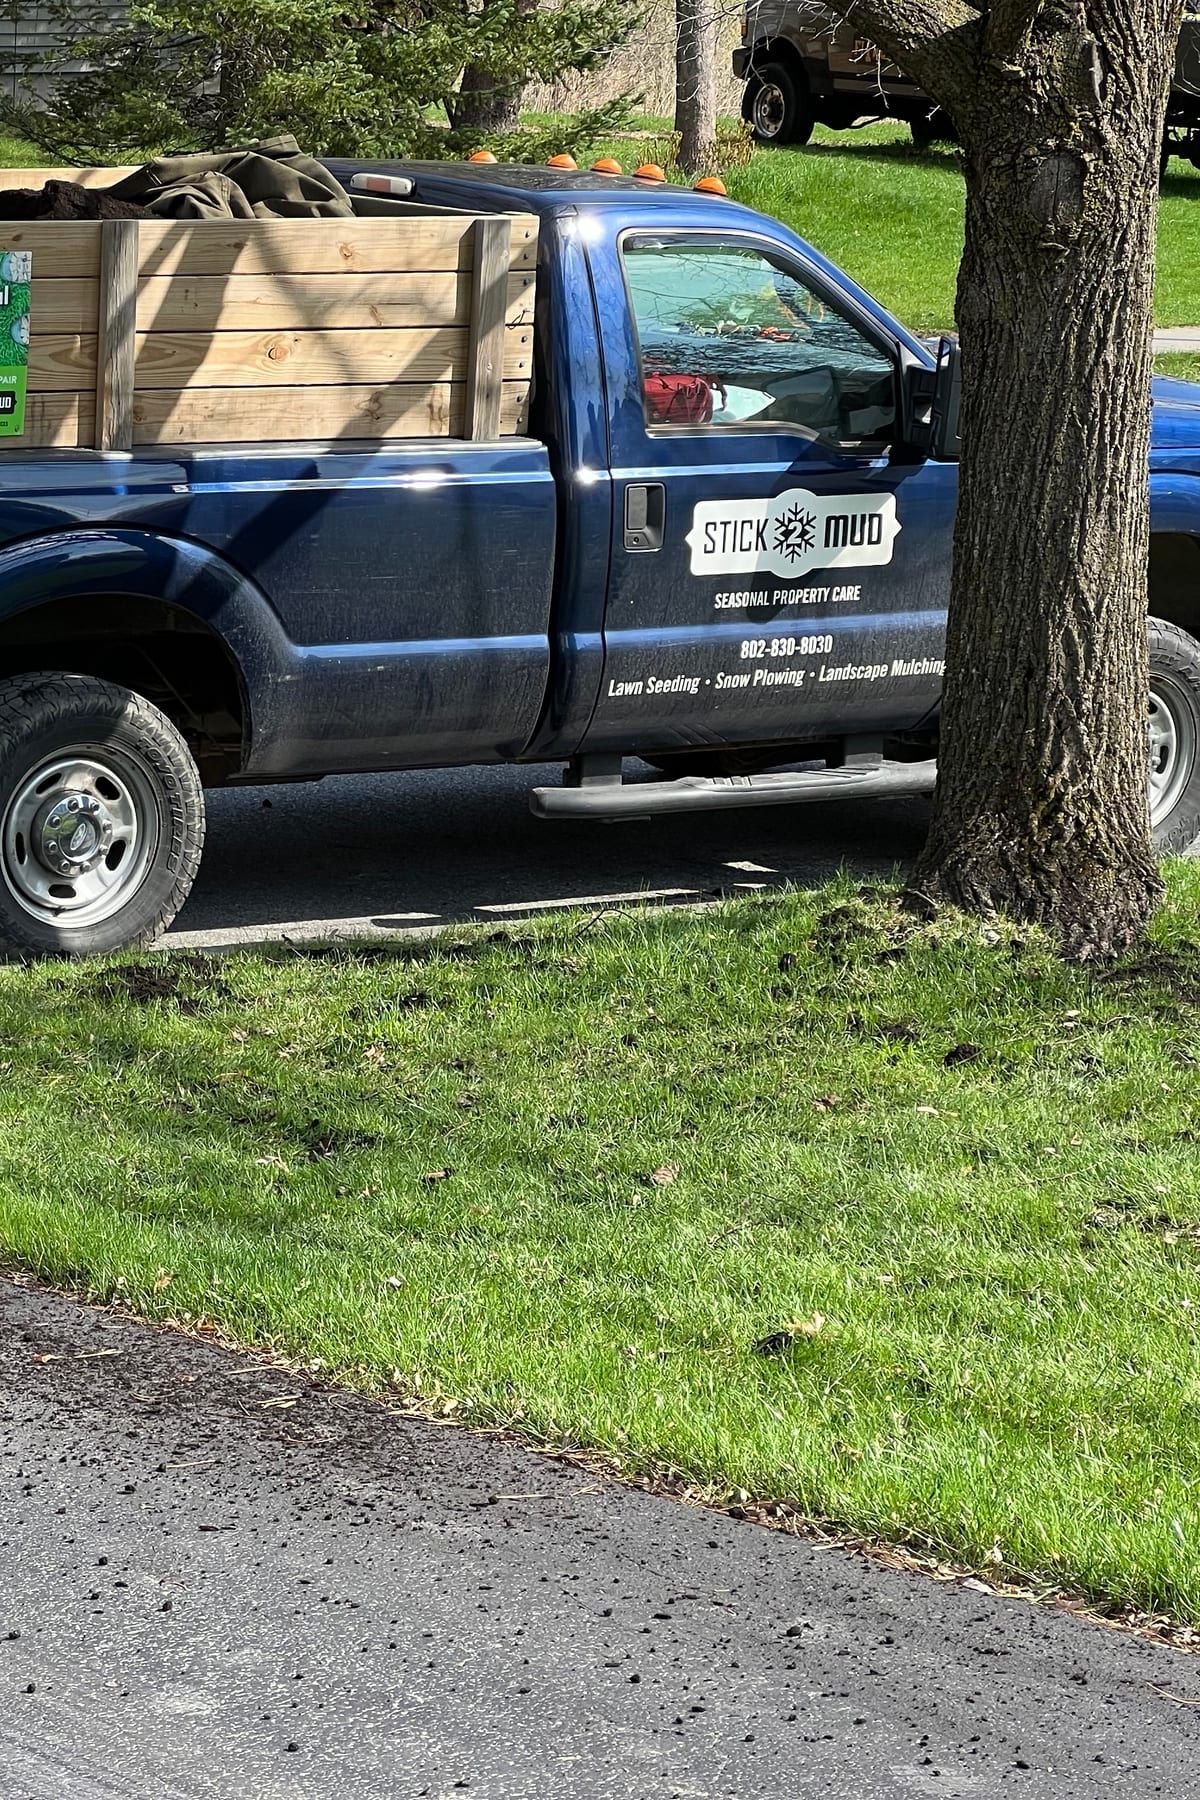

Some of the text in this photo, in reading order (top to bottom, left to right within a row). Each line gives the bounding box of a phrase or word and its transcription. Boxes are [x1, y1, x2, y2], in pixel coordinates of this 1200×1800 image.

[704, 513, 883, 554] STICK 2 MUD
[714, 585, 862, 609] SEASONAL PROPERTY CARE
[740, 634, 833, 659] 802-830-8030
[608, 657, 946, 697] Lawn Seeding Snow Plowing Landscape Mulching
[166, 792, 184, 875] TIRES
